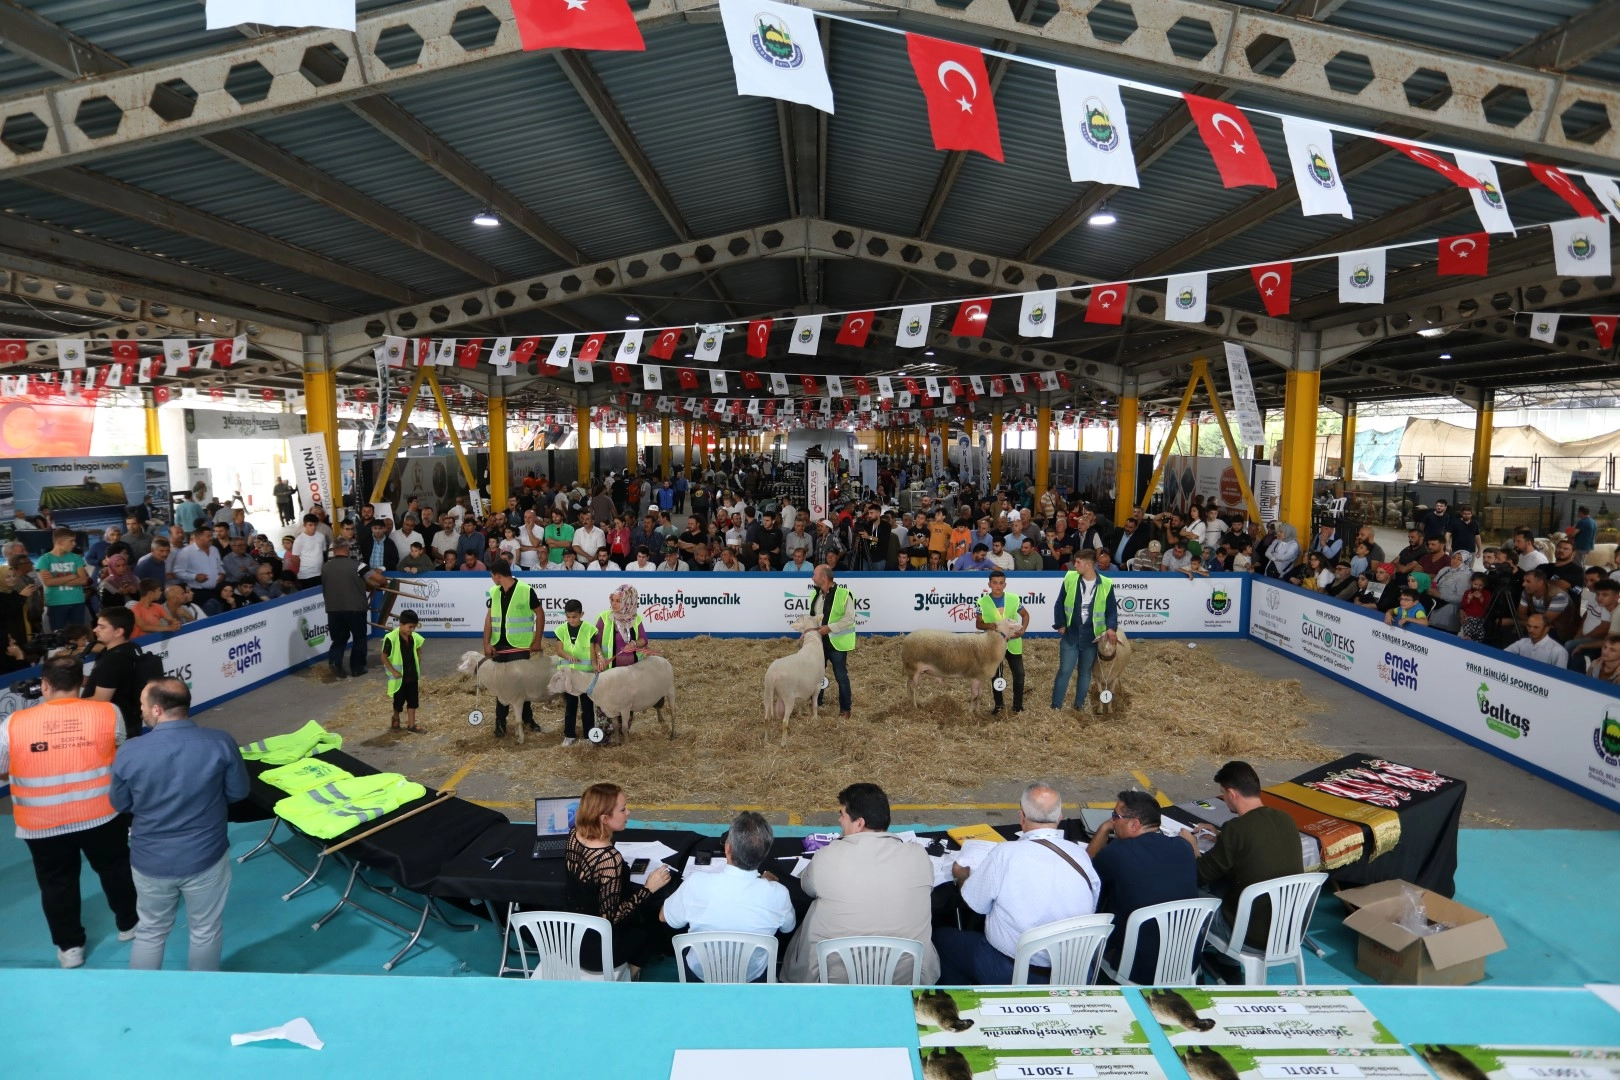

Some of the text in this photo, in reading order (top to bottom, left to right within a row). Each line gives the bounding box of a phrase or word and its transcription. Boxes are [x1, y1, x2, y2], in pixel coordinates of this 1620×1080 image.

[299, 447, 324, 509] ZOOTEKNİ
[675, 592, 741, 608] Hayvancılık
[643, 603, 685, 623] Festivali
[1324, 611, 1341, 623] SPONSOR
[243, 620, 267, 634] SPONSORU
[304, 624, 329, 640] Baltaş
[1302, 622, 1355, 654] GALKOTEKS
[228, 636, 261, 660] emek
[1402, 639, 1428, 655] SPONSORU
[237, 651, 262, 674] yem
[1385, 652, 1418, 676] emek
[997, 680, 1004, 689] 2
[1391, 670, 1418, 691] yem
[1466, 662, 1549, 697] YAKA İSİMLİĞİ SPONSORU
[473, 713, 478, 722] 5
[1481, 699, 1530, 737] Baltaş
[593, 730, 599, 740] 4
[1016, 1005, 1051, 1013] 5.000
[1018, 1067, 1073, 1076] 7.500 TL
[1282, 1067, 1339, 1075] 7.500 TL
